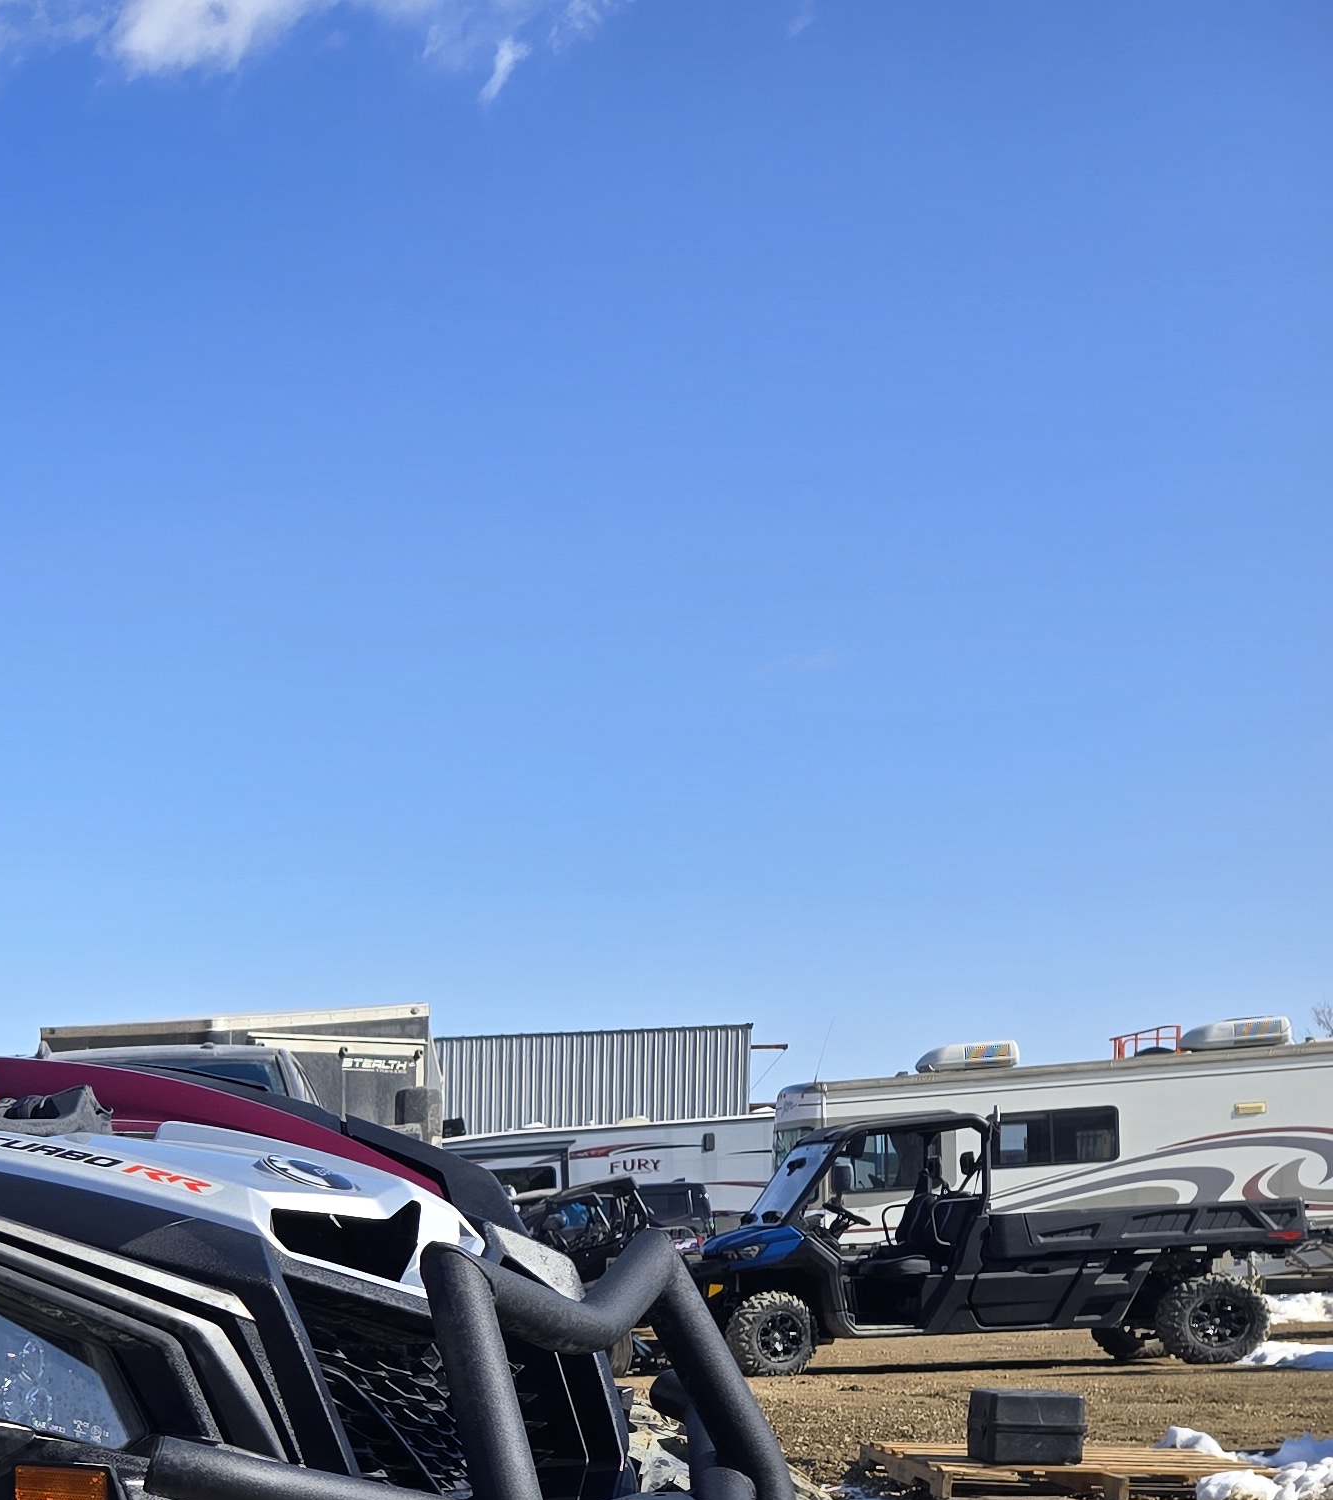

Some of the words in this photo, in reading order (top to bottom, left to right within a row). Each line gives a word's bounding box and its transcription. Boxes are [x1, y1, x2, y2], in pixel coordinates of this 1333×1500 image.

[342, 1058, 407, 1070] STEALTH
[609, 1158, 661, 1175] FURY
[121, 1164, 212, 1194] RR
